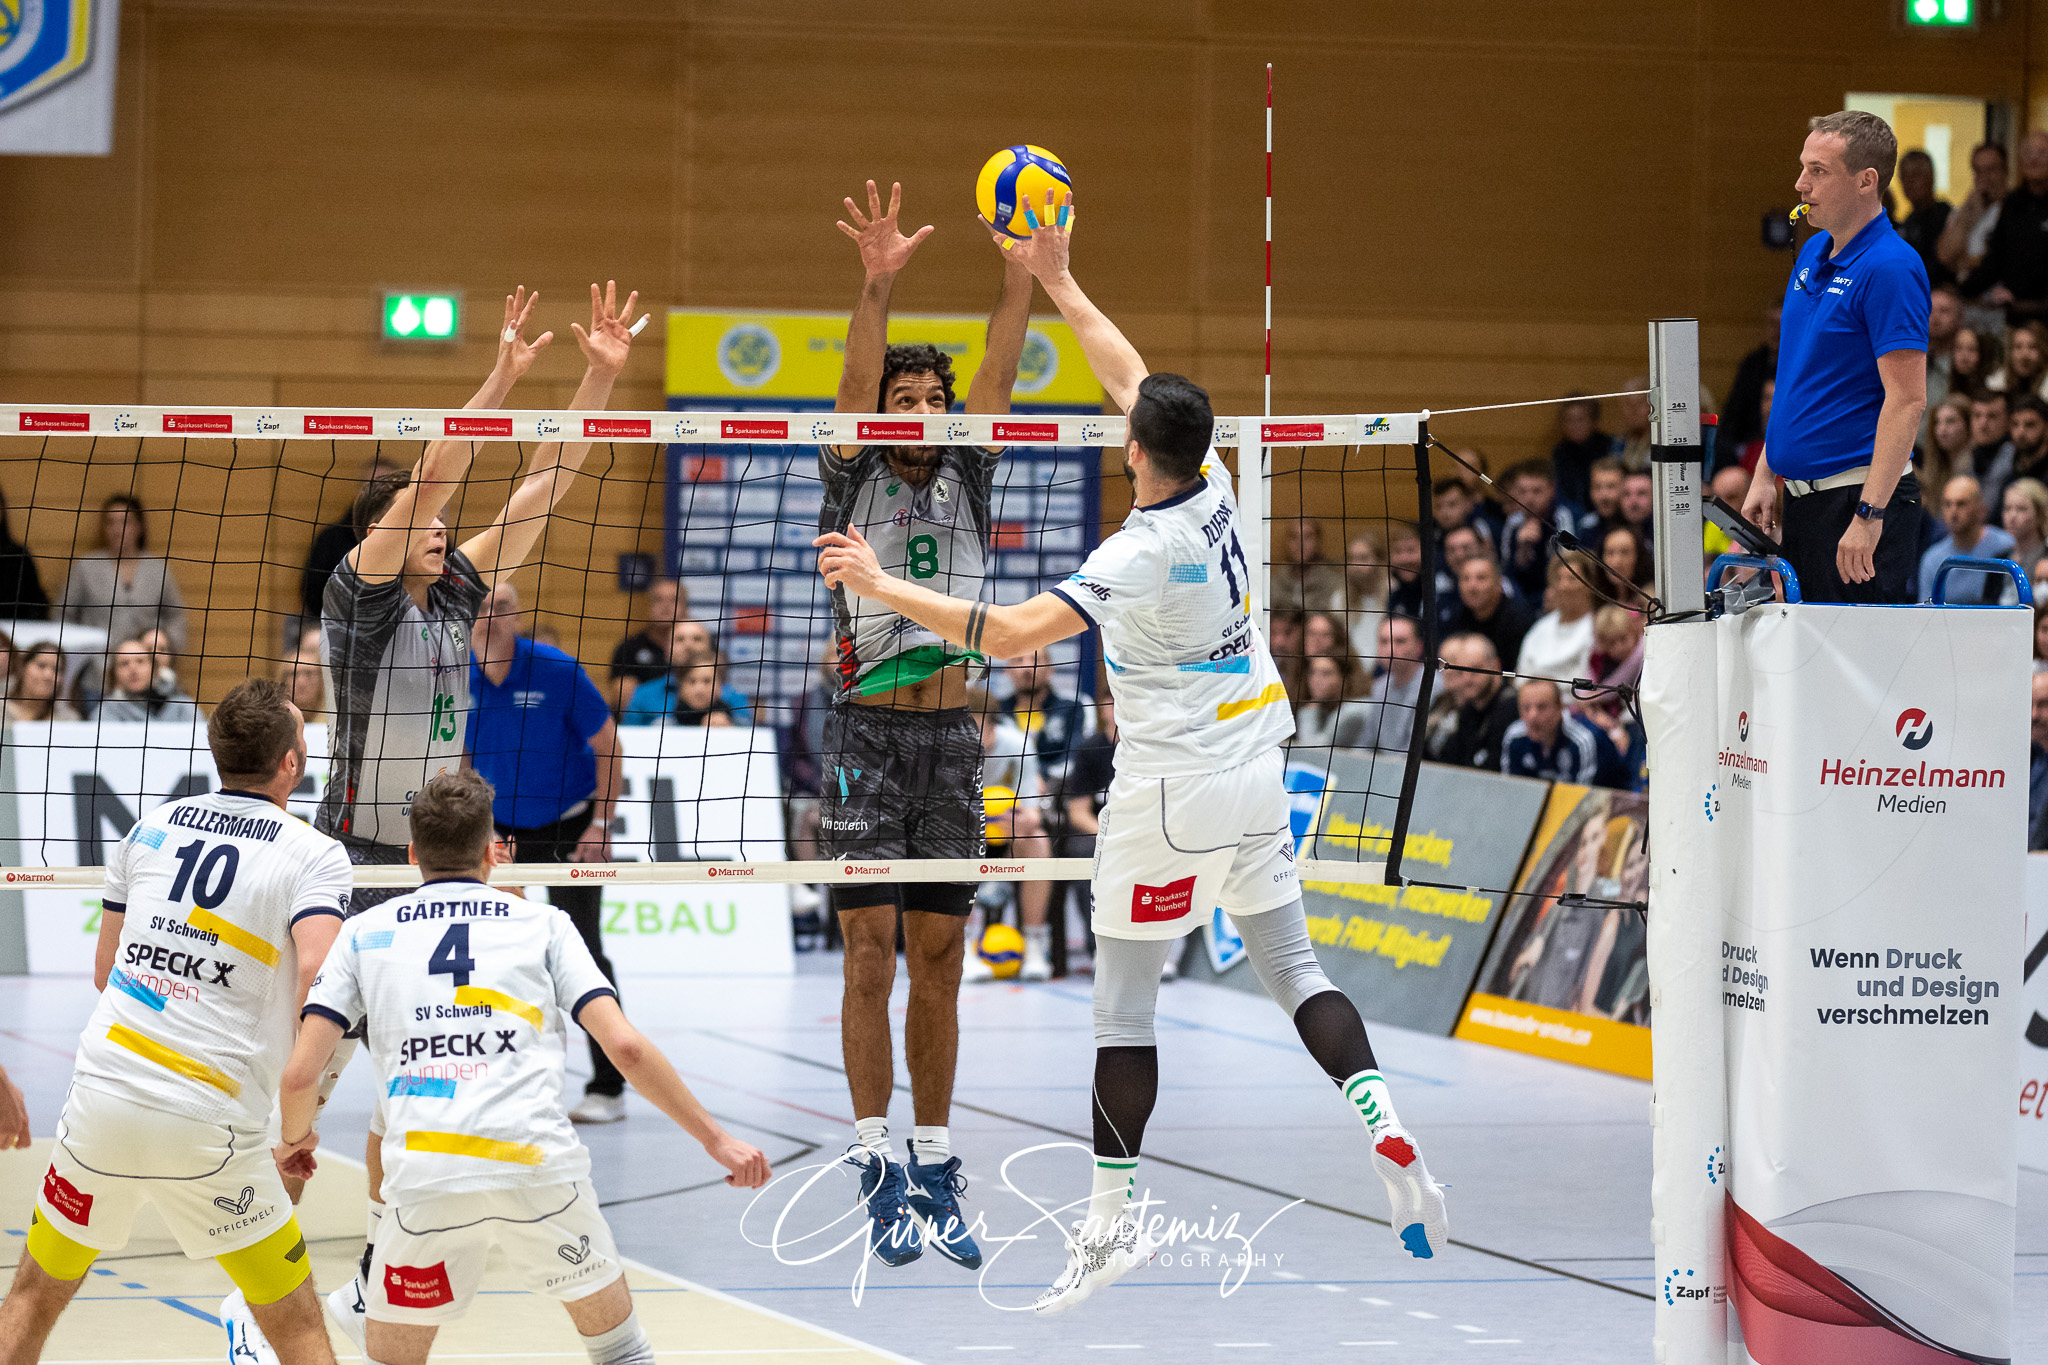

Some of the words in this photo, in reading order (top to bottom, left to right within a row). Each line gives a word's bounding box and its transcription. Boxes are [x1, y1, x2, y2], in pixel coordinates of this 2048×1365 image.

[34, 420, 60, 428] Sparkasse
[60, 420, 85, 428] Nürnberg
[120, 421, 138, 430] Zapf
[177, 421, 203, 430] Sparkasse
[203, 422, 228, 430] Nürnberg
[263, 422, 280, 431] Zapf
[318, 423, 344, 431] Sparkasse
[344, 423, 369, 431] Nürnberg
[404, 424, 420, 433] Zapf
[458, 425, 484, 433] Sparkasse
[484, 425, 508, 433] Nürnberg
[543, 425, 560, 434] Zapf
[597, 426, 622, 434] Sparkasse
[623, 426, 647, 434] Nürnberg
[1363, 424, 1390, 433] HUCK
[681, 427, 698, 436] Zapf
[735, 427, 759, 435] Sparkasse
[760, 428, 784, 436] Nürnberg
[818, 429, 834, 437] Zapf
[871, 429, 895, 437] Sparkasse
[896, 429, 920, 437] Nürnberg
[953, 430, 970, 438] Zapf
[1006, 430, 1030, 438] Sparkasse
[1031, 430, 1054, 439] Nürnberg
[1088, 431, 1104, 439] Zapf
[1221, 432, 1237, 440] Zapf
[1272, 431, 1296, 439] Sparkasse
[908, 533, 939, 579] 8
[1220, 527, 1250, 609] 11
[1820, 758, 2006, 788] Heinzelmann
[1731, 773, 1751, 790] Medien
[1877, 794, 1947, 814] Medien
[168, 805, 283, 842] KELLERMANN
[167, 839, 240, 909] 10
[580, 869, 617, 878] Marmot
[718, 868, 754, 877] Marmot
[854, 866, 890, 875] Marmot
[990, 865, 1025, 873] Marmot
[16, 873, 54, 882] Marmot
[1155, 889, 1190, 903] Sparkasse
[397, 900, 509, 923] GÄRTNER
[1155, 900, 1187, 912] Nürnberg
[151, 916, 166, 930] SV
[167, 919, 220, 946] Schwaig
[428, 923, 475, 987] 4
[1722, 941, 1758, 964] Druck
[1810, 948, 1879, 968] Wenn
[1886, 948, 1962, 969] Druck
[124, 943, 207, 981] SPECK
[119, 970, 199, 1003] pumpen
[1732, 967, 1769, 995] Design
[1857, 975, 1905, 997] und
[1912, 975, 1999, 1004] Design
[415, 1006, 431, 1021] SV
[436, 1001, 492, 1019] Schwaig
[1817, 1004, 1989, 1025] verschmelzen
[400, 1032, 487, 1066] SPECK
[401, 1062, 488, 1090] pumpen
[57, 1184, 84, 1208] Sparkasse
[208, 1206, 276, 1237] OFFICEWELT
[546, 1258, 608, 1288] OFFICEWELT
[404, 1277, 440, 1289] Sparkasse
[404, 1289, 441, 1300] Nürnberg
[1676, 1286, 1711, 1301] Zapf
